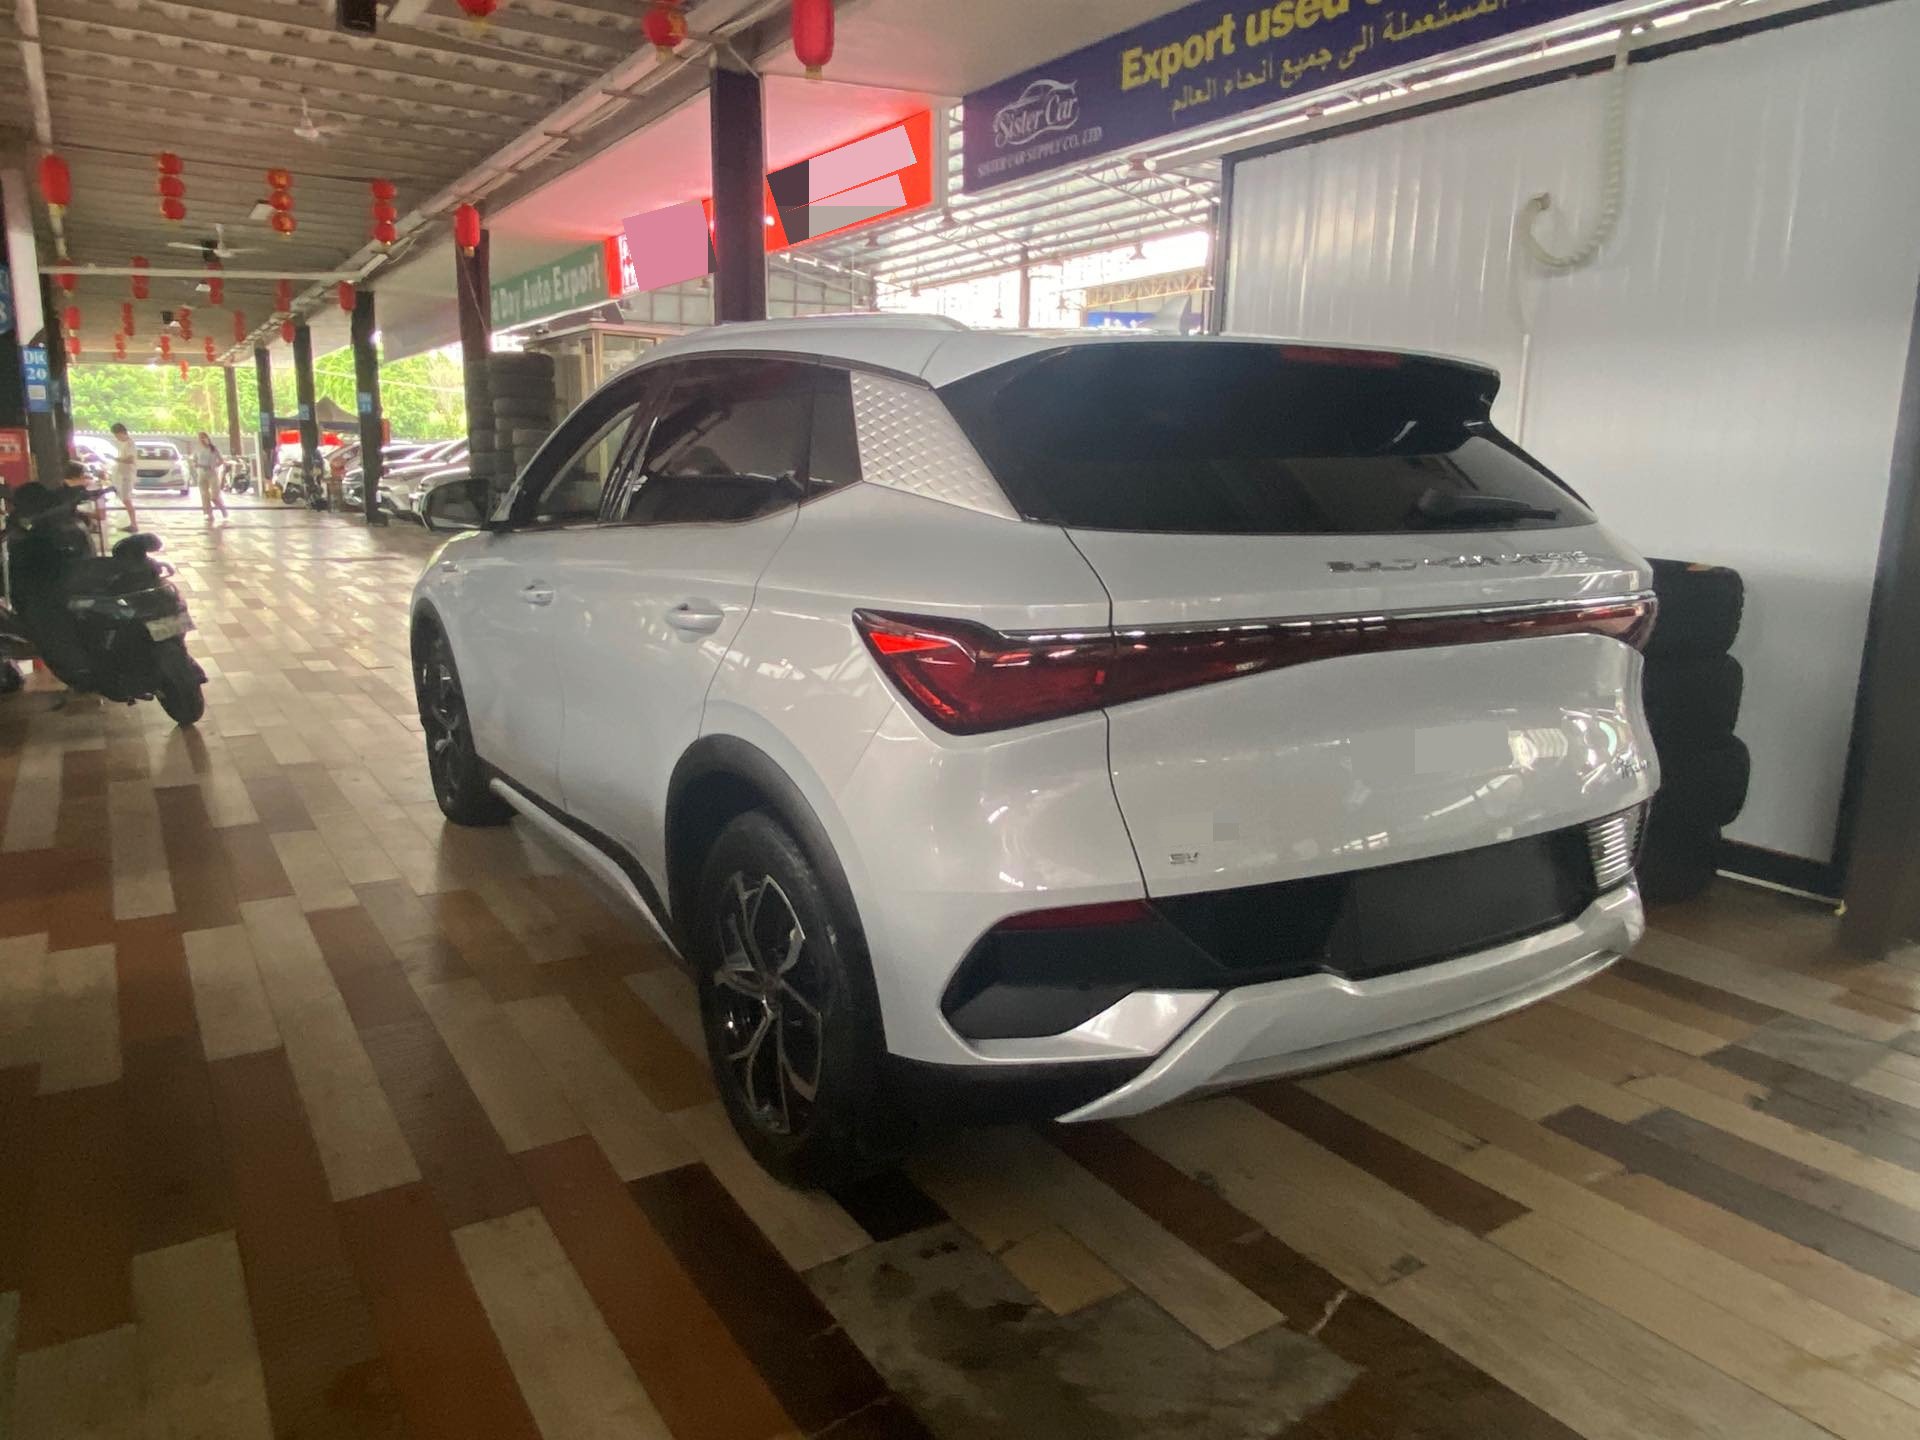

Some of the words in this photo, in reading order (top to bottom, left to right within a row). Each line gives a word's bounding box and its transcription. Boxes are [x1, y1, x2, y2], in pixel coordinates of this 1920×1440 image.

[1121, 13, 1236, 90] Export
[1280, 48, 1333, 89] جميع
[994, 108, 1044, 148] Sister
[1045, 93, 1078, 125] Car
[552, 252, 600, 305] Export
[24, 350, 47, 364] DK
